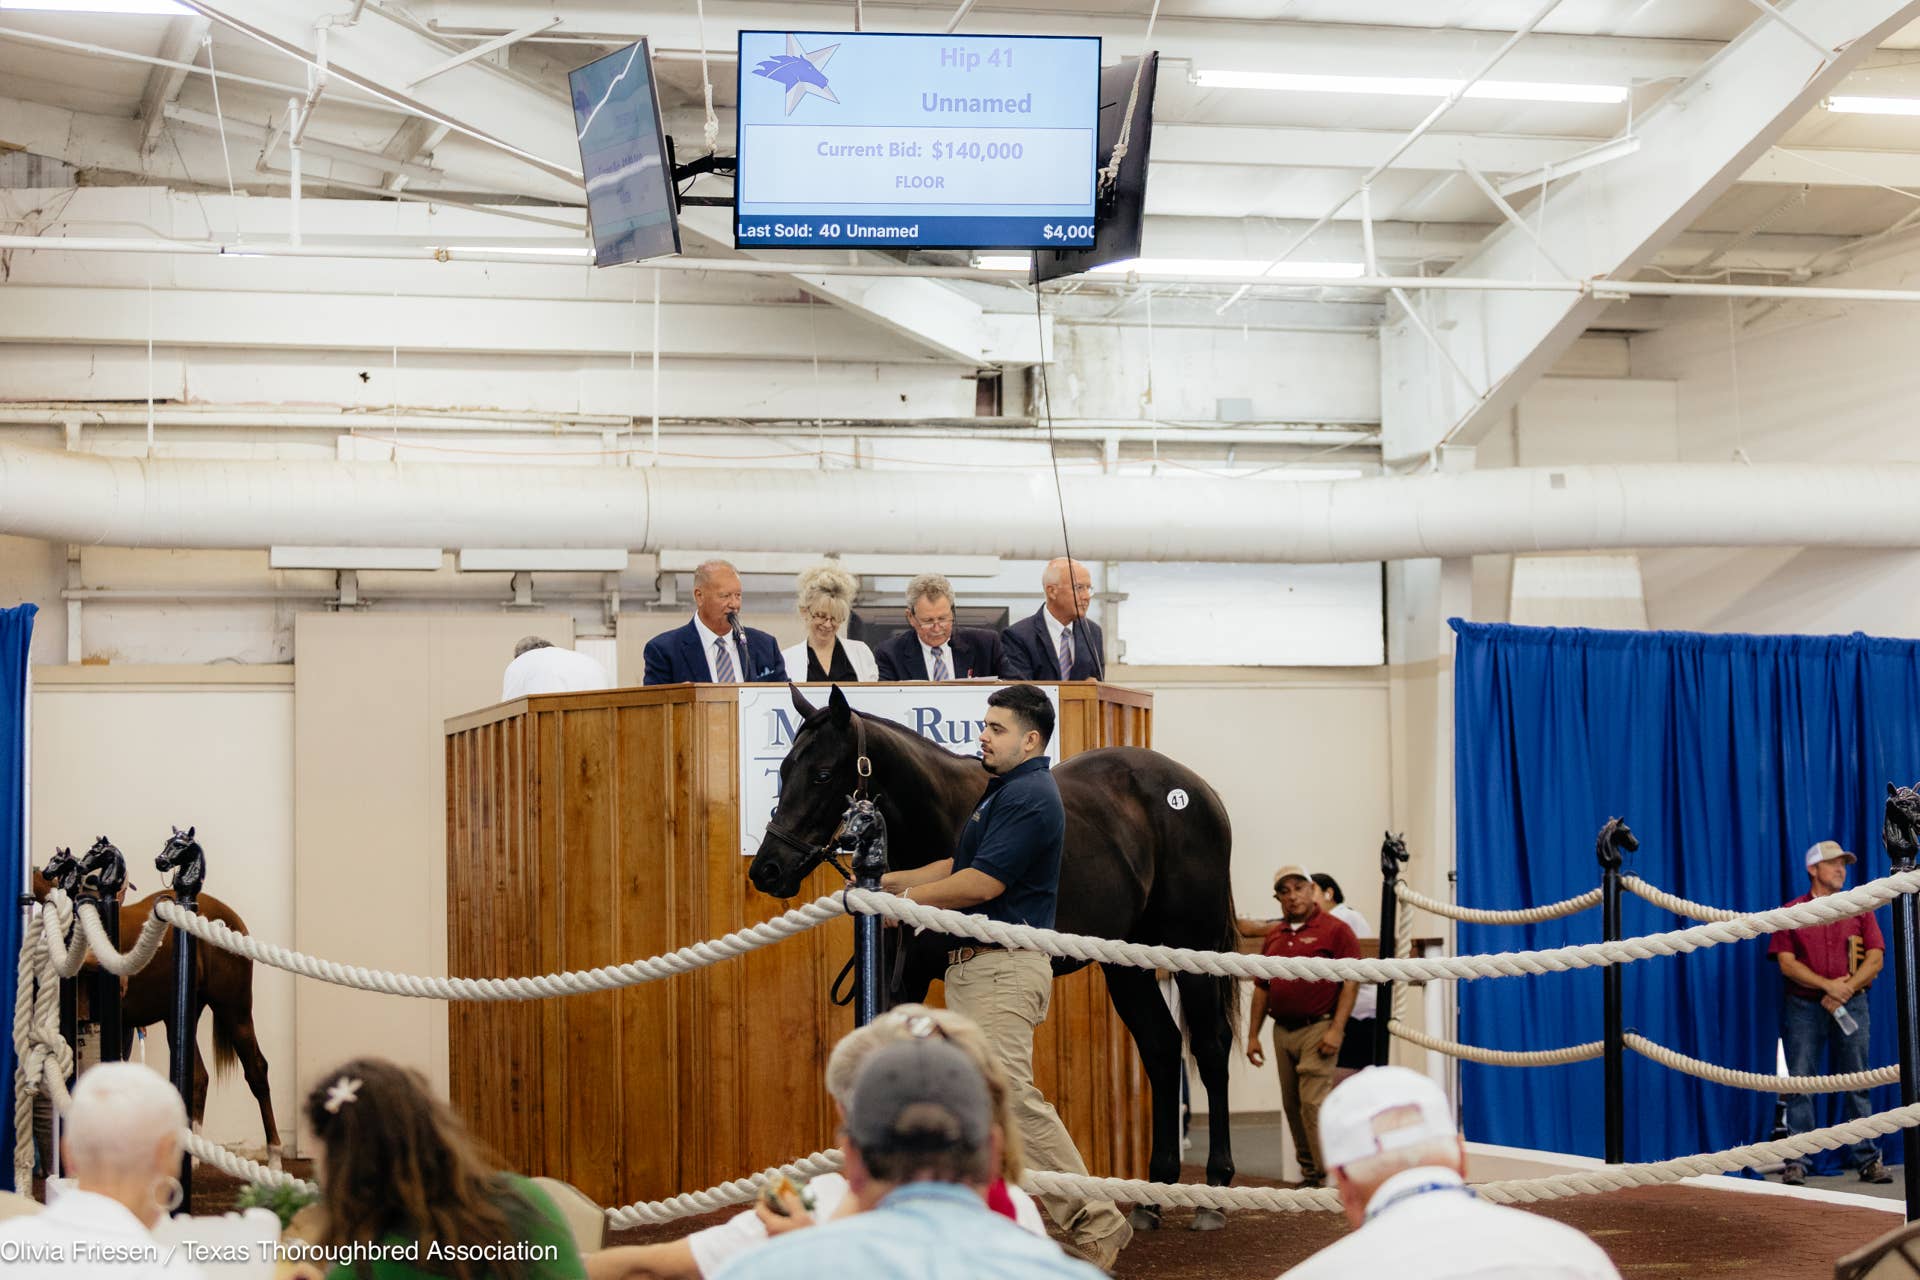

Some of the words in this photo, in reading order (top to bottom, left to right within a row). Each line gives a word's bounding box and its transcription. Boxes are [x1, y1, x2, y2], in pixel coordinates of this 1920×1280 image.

[940, 46, 980, 71] Hip
[987, 47, 1013, 68] 41
[921, 91, 1033, 114] Unnamed
[816, 140, 884, 159] Current
[888, 140, 923, 159] Bid:
[931, 139, 1024, 162] $140,000
[895, 174, 946, 190] FLOOR
[738, 223, 771, 238] Last
[774, 223, 813, 238] Sold:
[819, 223, 841, 238] 40
[846, 223, 919, 238] Unnamed
[1171, 794, 1185, 808] 41
